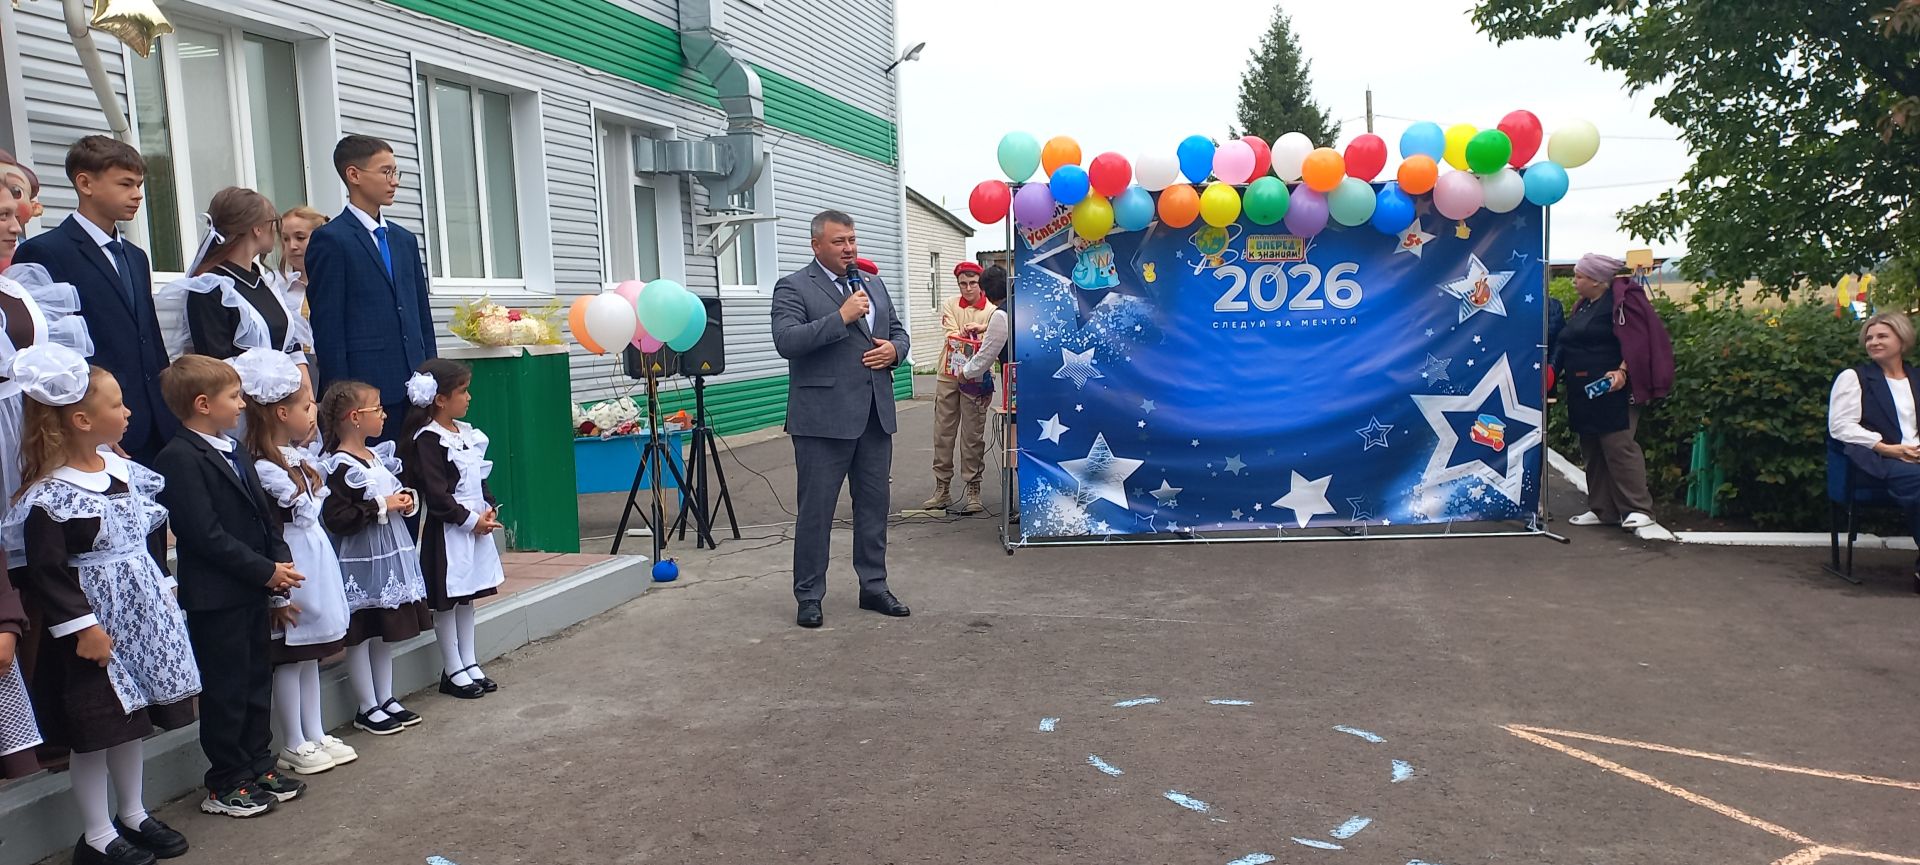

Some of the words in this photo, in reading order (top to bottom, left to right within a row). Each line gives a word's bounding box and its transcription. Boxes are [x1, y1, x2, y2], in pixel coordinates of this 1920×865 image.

[1404, 233, 1422, 247] 5+
[1213, 262, 1363, 312] 2026
[1212, 320, 1266, 329] СЛЕДУЙ
[1276, 320, 1291, 328] ЗА
[1301, 316, 1357, 327] МЕЧТОЙ
